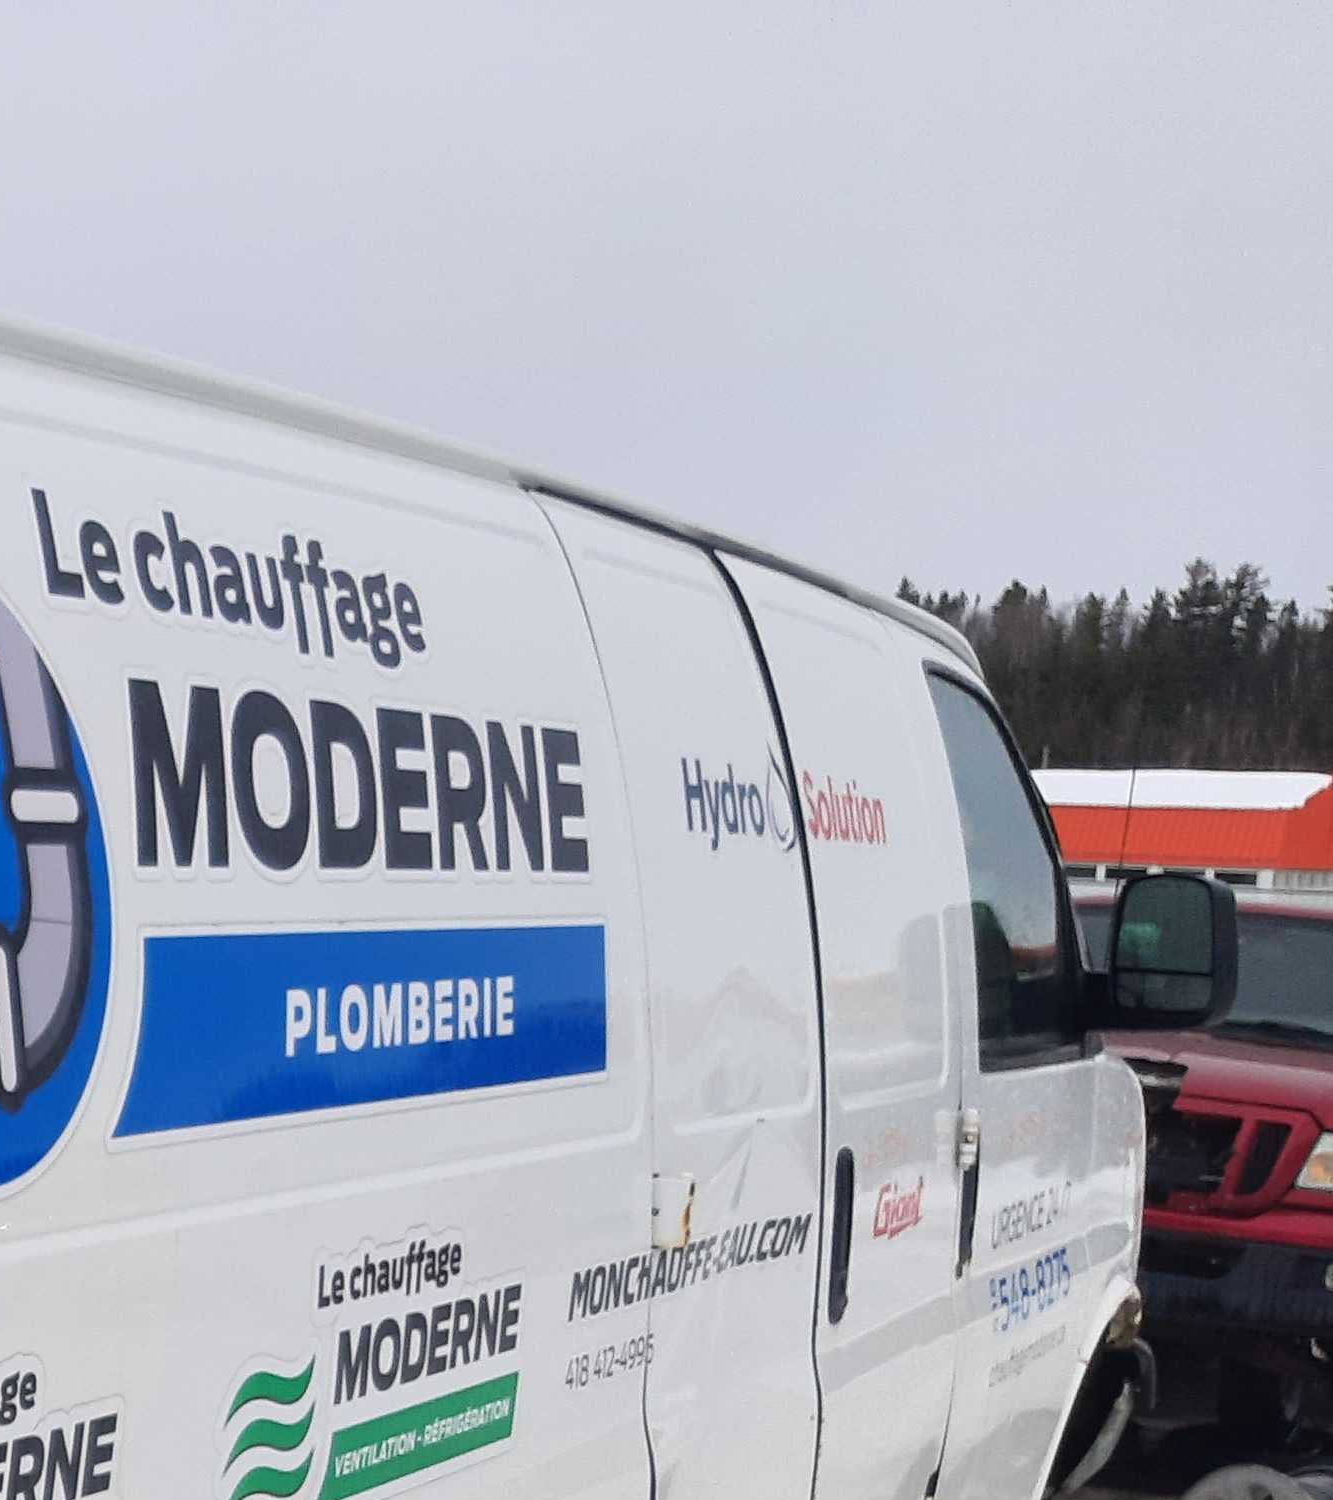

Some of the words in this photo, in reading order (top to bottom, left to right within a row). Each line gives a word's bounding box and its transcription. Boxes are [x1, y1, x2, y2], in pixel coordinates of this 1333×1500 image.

[30, 487, 125, 605] Le
[133, 510, 427, 669] chauffage
[127, 677, 591, 876] MODERNE
[681, 756, 766, 851] Hydro
[803, 769, 888, 846] Solution
[283, 974, 517, 1058] PLOMBERIE
[318, 1264, 346, 1310] Le
[349, 1239, 463, 1301] chauffage
[333, 1284, 523, 1406] MODERNE
[334, 1431, 417, 1479] VENTILATION
